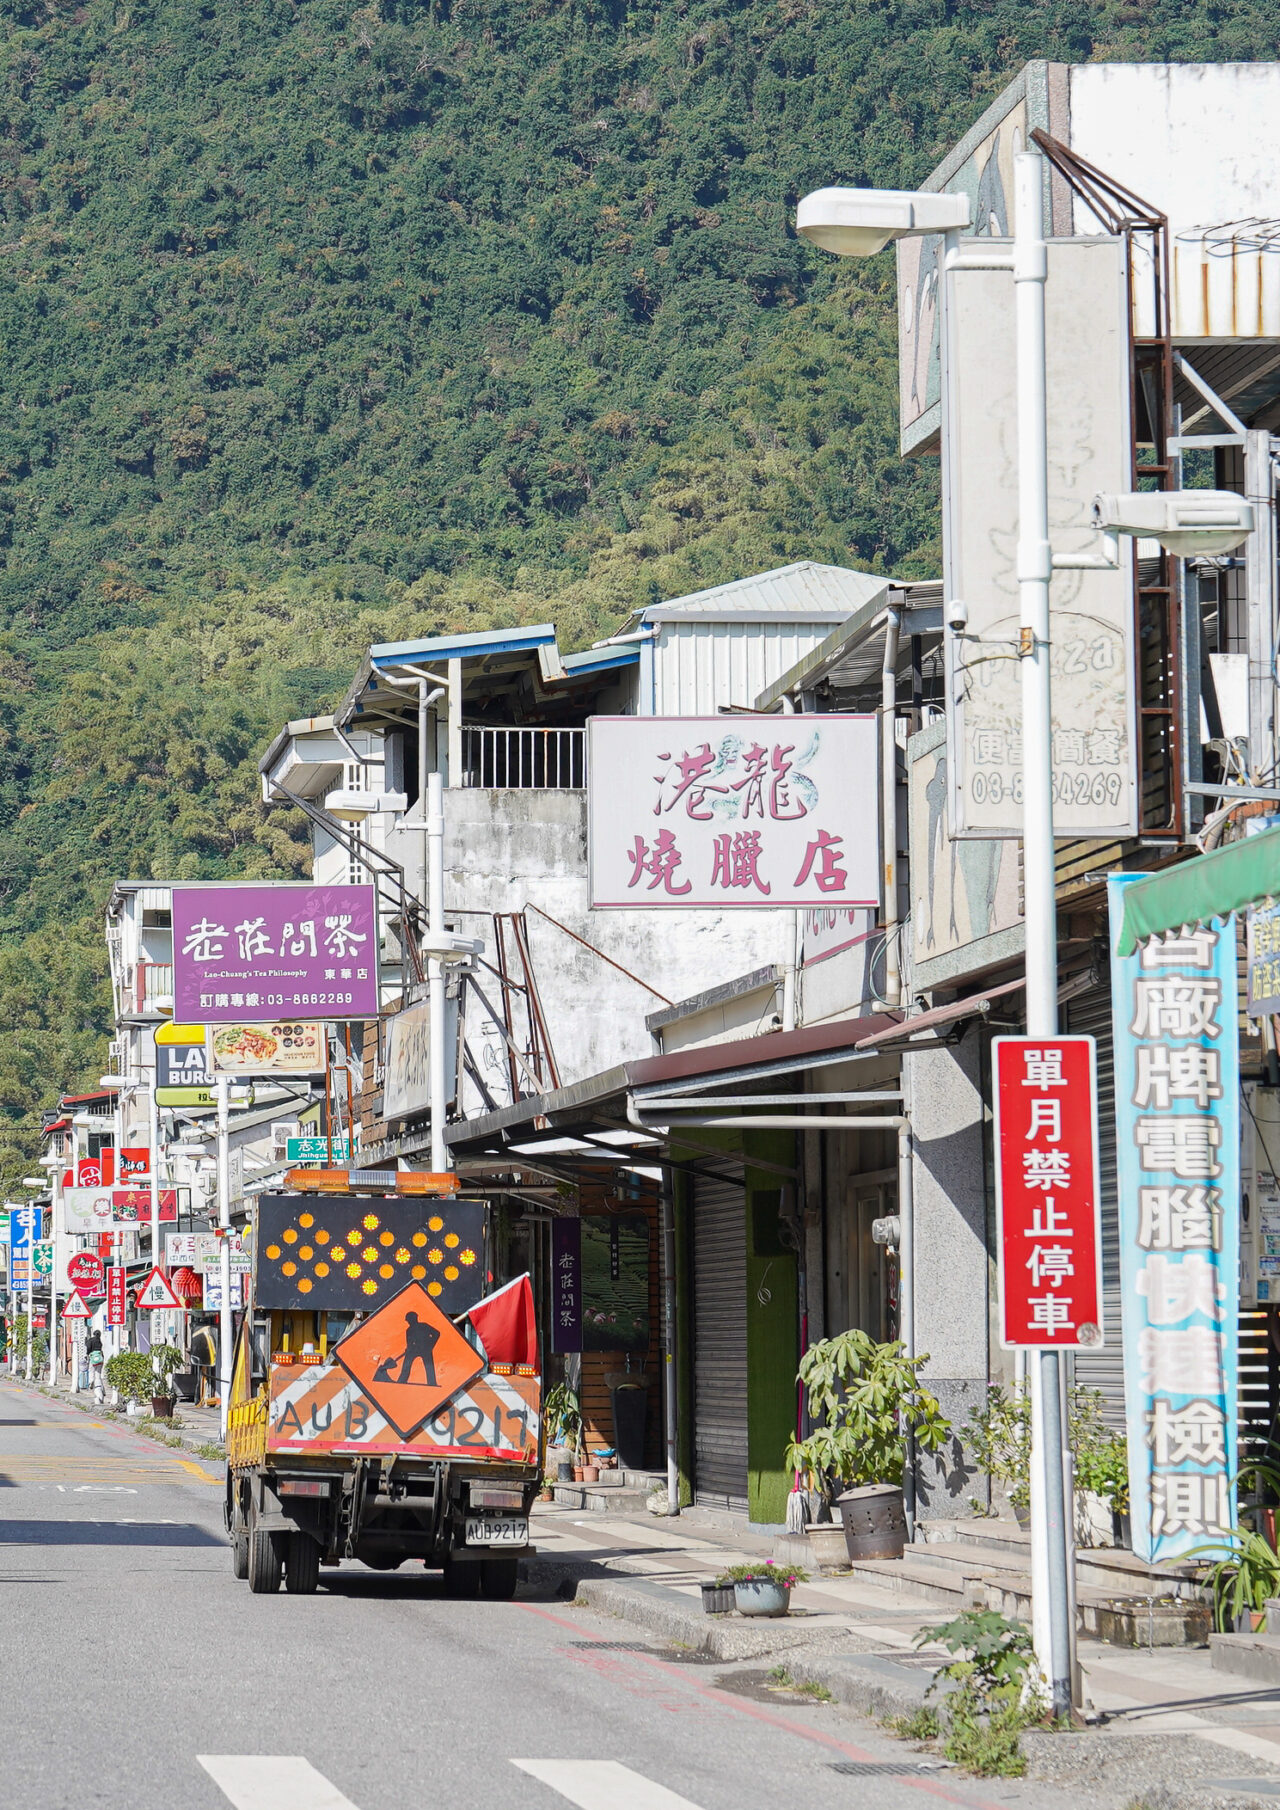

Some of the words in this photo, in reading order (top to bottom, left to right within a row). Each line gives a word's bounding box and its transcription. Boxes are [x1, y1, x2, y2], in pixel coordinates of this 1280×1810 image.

[979, 636, 1115, 687] pza
[652, 742, 808, 821] 港龍
[972, 772, 1122, 806] 03-84269
[627, 828, 849, 896] 燒臘店
[181, 915, 367, 962] 老莊問茶
[253, 969, 267, 978] Tea
[268, 968, 308, 979] Philosophy
[324, 968, 368, 980] 東華店
[168, 1047, 206, 1069] LA
[169, 1070, 237, 1084] BURGR
[298, 1139, 348, 1152] 志光街
[1021, 1049, 1076, 1336] 單月禁止停車
[71, 1301, 81, 1313] 慢
[111, 1268, 122, 1323] 單月禁止停車
[149, 1286, 165, 1302] 慢
[559, 1252, 576, 1327] 老莊問茶
[276, 1391, 368, 1440] AUB
[430, 1404, 528, 1448] 9217
